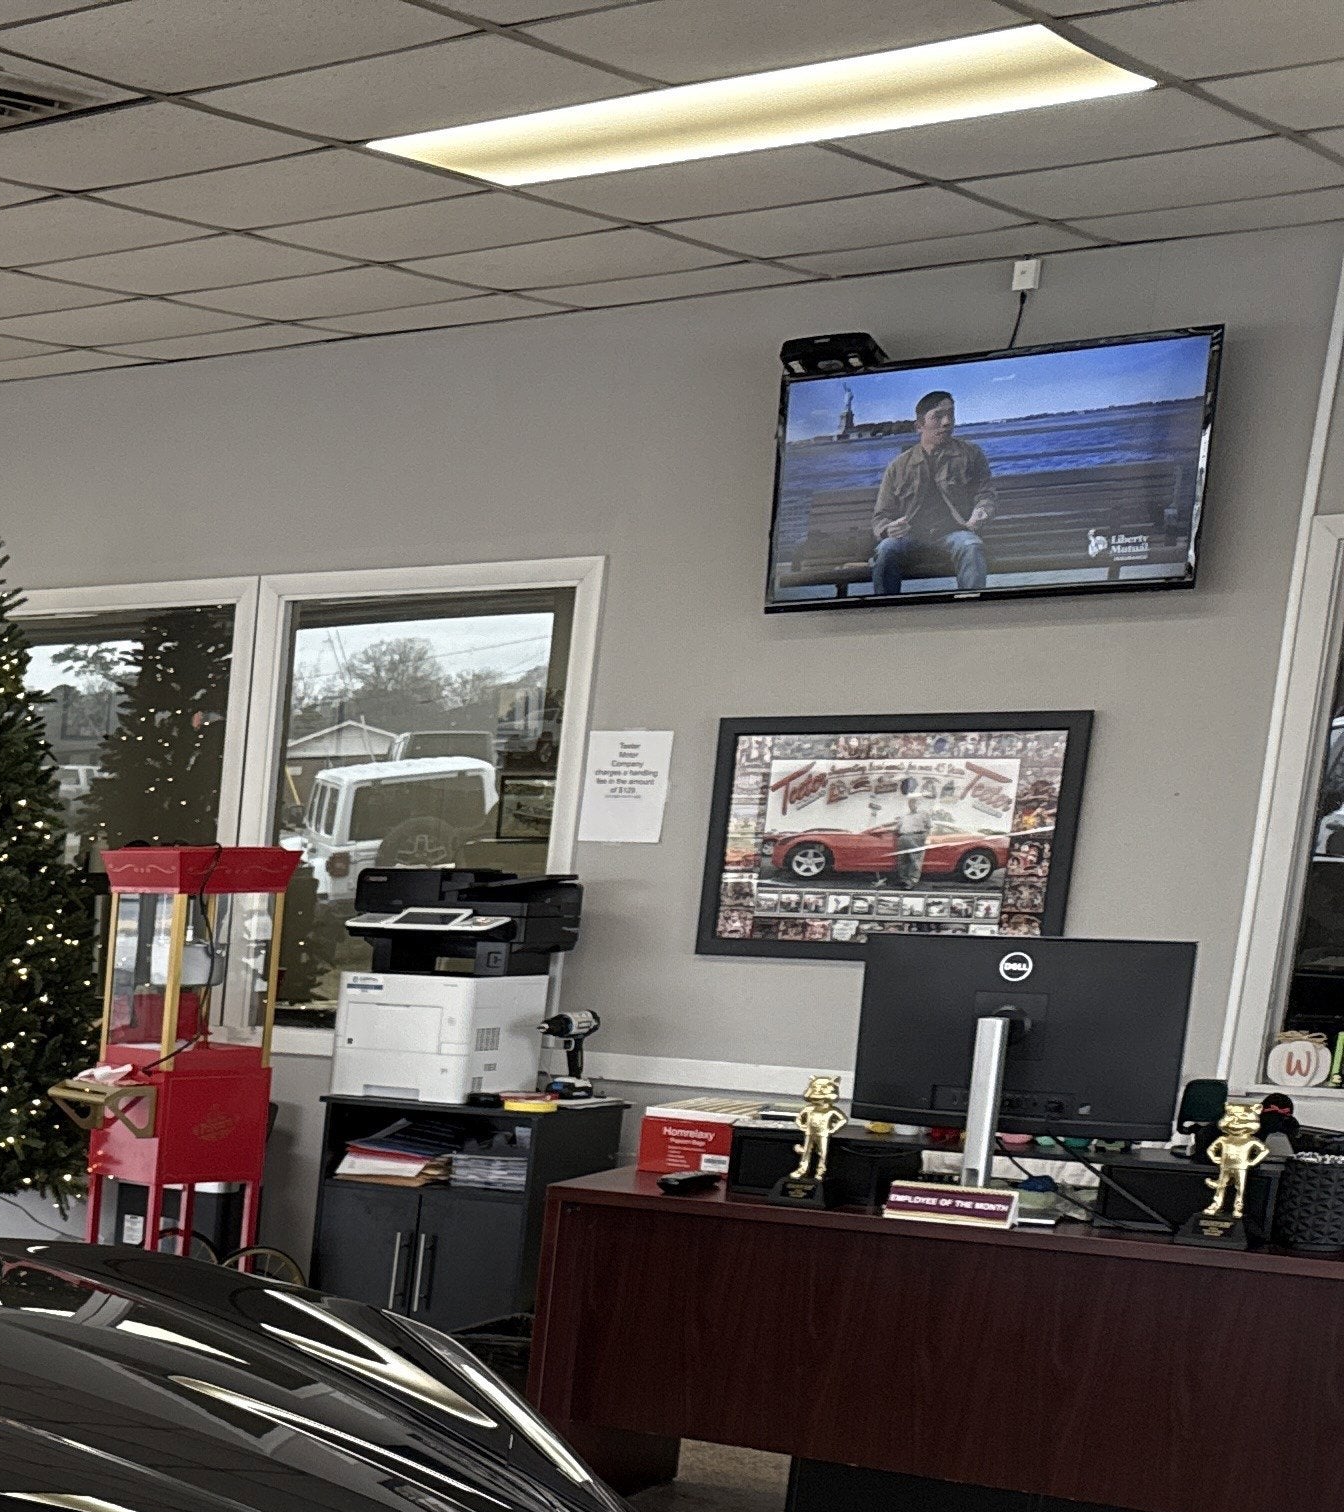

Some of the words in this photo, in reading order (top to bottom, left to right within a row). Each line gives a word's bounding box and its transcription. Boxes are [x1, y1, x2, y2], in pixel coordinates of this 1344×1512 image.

[1112, 535, 1149, 544] Liberty
[1111, 543, 1149, 553] Mutual
[612, 760, 644, 768] Company
[629, 770, 658, 778] handling
[1004, 962, 1028, 970] DELL
[1286, 1051, 1310, 1077] W
[662, 1126, 715, 1141] Homrelaxy
[889, 1194, 937, 1206] EMPLOYEE
[939, 1199, 952, 1207] OF
[954, 1200, 972, 1209] THE
[974, 1202, 1009, 1211] MONTH
